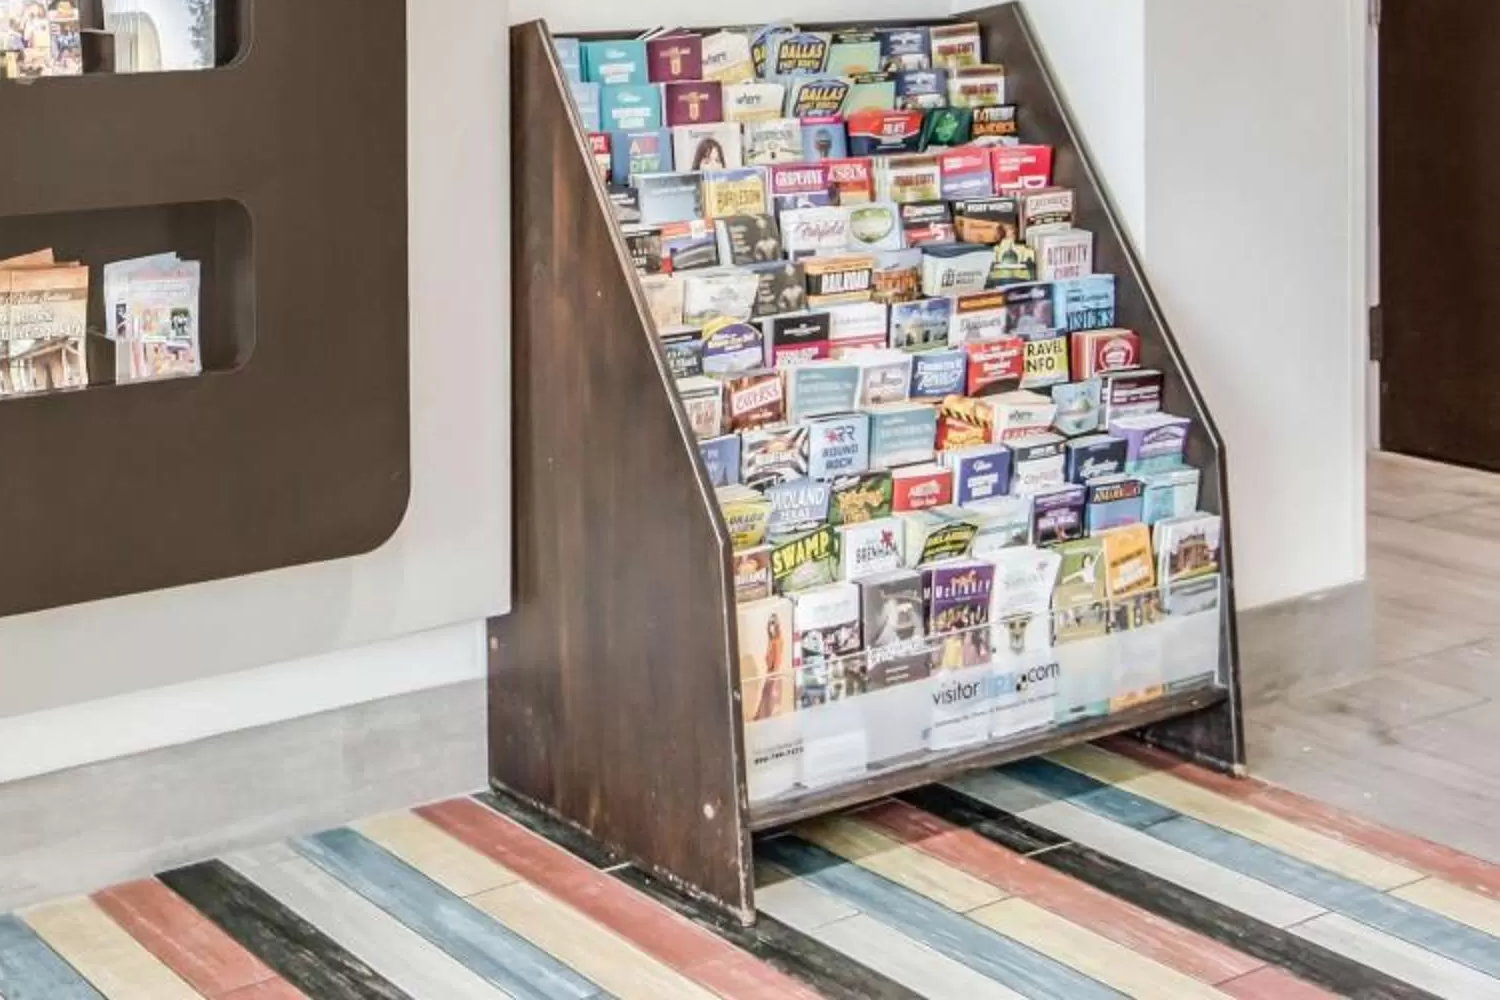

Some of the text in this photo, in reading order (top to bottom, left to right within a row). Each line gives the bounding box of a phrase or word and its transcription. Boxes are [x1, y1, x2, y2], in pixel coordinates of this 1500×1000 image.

[780, 43, 823, 59] DALLAS
[1027, 341, 1063, 357] RAVEL
[1026, 357, 1056, 373] NFO
[772, 530, 830, 574] SWAMP
